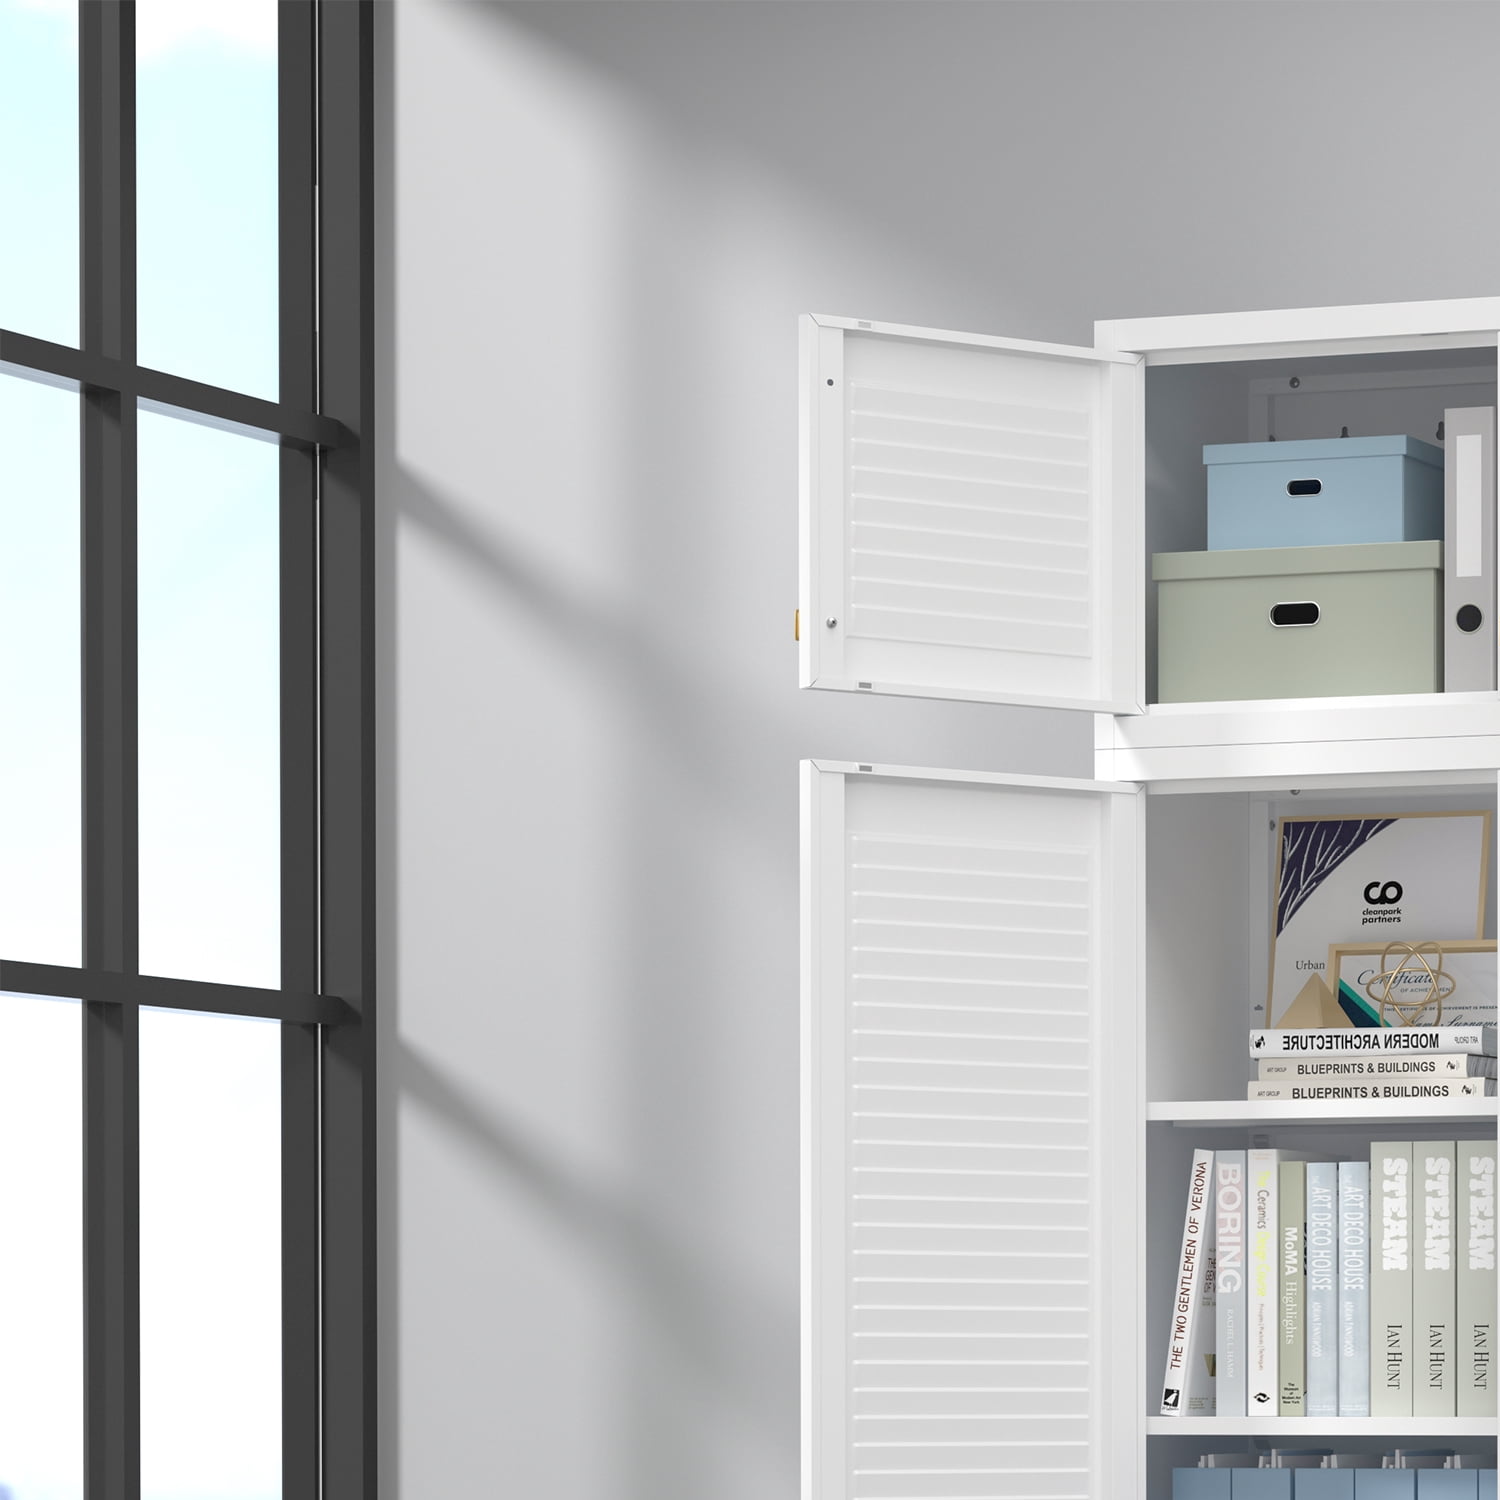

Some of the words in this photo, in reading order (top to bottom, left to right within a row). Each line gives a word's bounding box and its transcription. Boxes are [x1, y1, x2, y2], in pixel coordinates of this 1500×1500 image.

[1361, 916, 1402, 925] partners
[1362, 908, 1402, 917] cleanpark
[1295, 960, 1325, 970] Urban
[1357, 970, 1435, 989] Certificat
[1297, 1063, 1364, 1075] BLUEPRINTS
[1367, 1063, 1375, 1073] &
[1378, 1061, 1436, 1073] BUILDINGS
[1292, 1087, 1368, 1099] BLUEPRINTS
[1372, 1086, 1380, 1098] &
[1384, 1086, 1449, 1098] BUILDINGS
[1191, 1161, 1207, 1212] VERONA
[1312, 1186, 1332, 1208] ART
[1344, 1186, 1364, 1208] ART
[1188, 1216, 1199, 1234] OF
[1257, 1189, 1270, 1229] Ceramics
[1382, 1158, 1408, 1271] STEAM
[1424, 1157, 1450, 1271] STEAM
[1469, 1156, 1495, 1271] STEAM
[1217, 1163, 1242, 1293] BORING
[1312, 1212, 1332, 1246] DECO
[1344, 1212, 1364, 1246] DECO
[1284, 1227, 1298, 1276] MoMA
[1178, 1239, 1197, 1313] GENTLEMEN
[1312, 1250, 1332, 1290] HOUSE
[1344, 1250, 1364, 1290] HOUSE
[1174, 1315, 1187, 1341] TWO
[1282, 1282, 1297, 1345] Highlights
[1387, 1324, 1402, 1348] IAN
[1429, 1324, 1445, 1348] IAN
[1473, 1324, 1489, 1348] IAN
[1170, 1346, 1183, 1370] THE
[1387, 1352, 1402, 1390] HUNT
[1429, 1352, 1445, 1390] HUNT
[1473, 1352, 1489, 1390] HUNT
